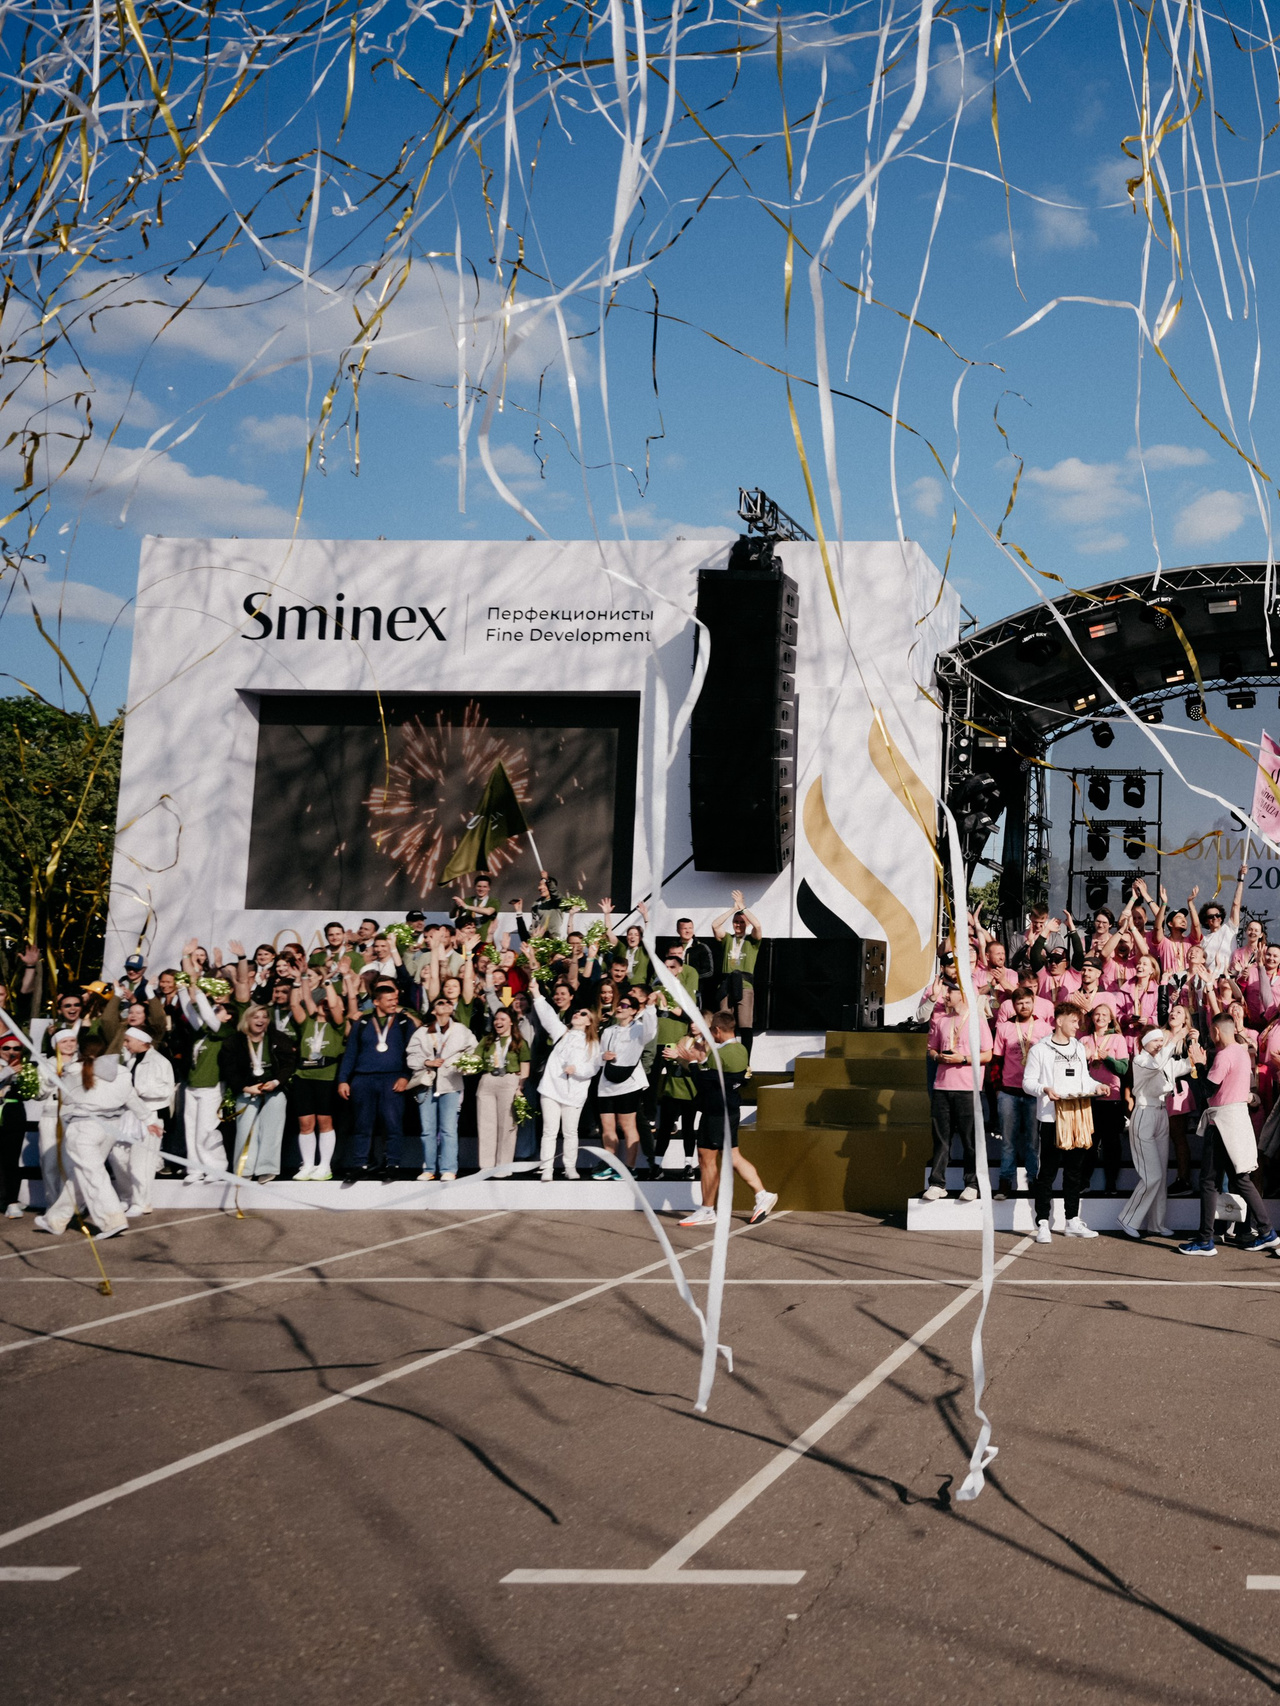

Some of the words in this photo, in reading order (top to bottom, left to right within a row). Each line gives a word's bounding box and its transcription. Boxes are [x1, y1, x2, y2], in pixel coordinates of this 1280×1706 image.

[240, 591, 447, 642] Sminex
[487, 606, 654, 623] Перфекционисты
[486, 628, 524, 642] Fine
[529, 628, 651, 645] Development
